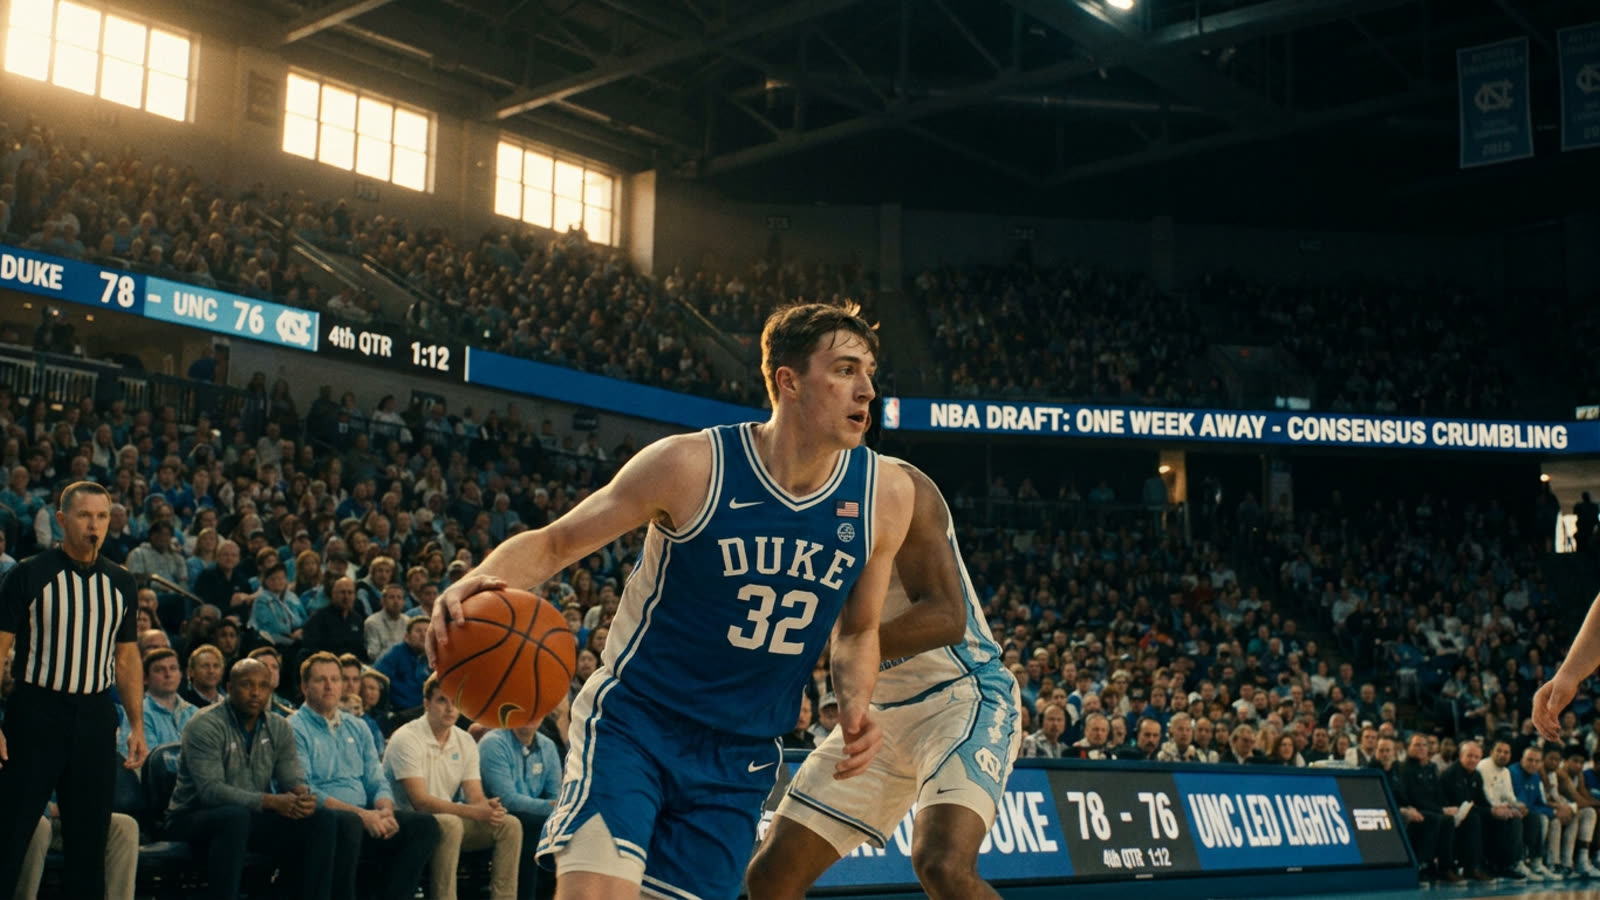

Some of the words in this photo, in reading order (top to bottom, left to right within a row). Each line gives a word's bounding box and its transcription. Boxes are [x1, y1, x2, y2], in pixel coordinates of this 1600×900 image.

[1, 254, 64, 290] DUKE
[100, 271, 135, 308] 78
[173, 291, 218, 323] UNC
[233, 300, 265, 335] 76
[328, 325, 355, 350] 4th
[358, 331, 393, 357] QTR
[411, 341, 450, 371] 1:12
[930, 403, 981, 428] NBA
[986, 405, 1070, 432] DRAFT:
[1076, 408, 1125, 434] ONE
[1130, 410, 1195, 436] WEEK
[1199, 413, 1266, 439] AWAY
[1271, 425, 1282, 433] -
[1287, 416, 1427, 445] CONSENSUS
[1432, 421, 1568, 449] CRUMBLING
[717, 536, 856, 591] DUKE
[727, 583, 819, 655] 32
[1066, 791, 1112, 841] 78
[1120, 812, 1133, 822] -
[1138, 792, 1179, 839] 76
[1187, 794, 1243, 848] UNC
[1235, 794, 1282, 847] LED
[1274, 794, 1350, 845] LIGHTS
[1121, 847, 1145, 869] QTR
[1147, 847, 1172, 867] 1:12
